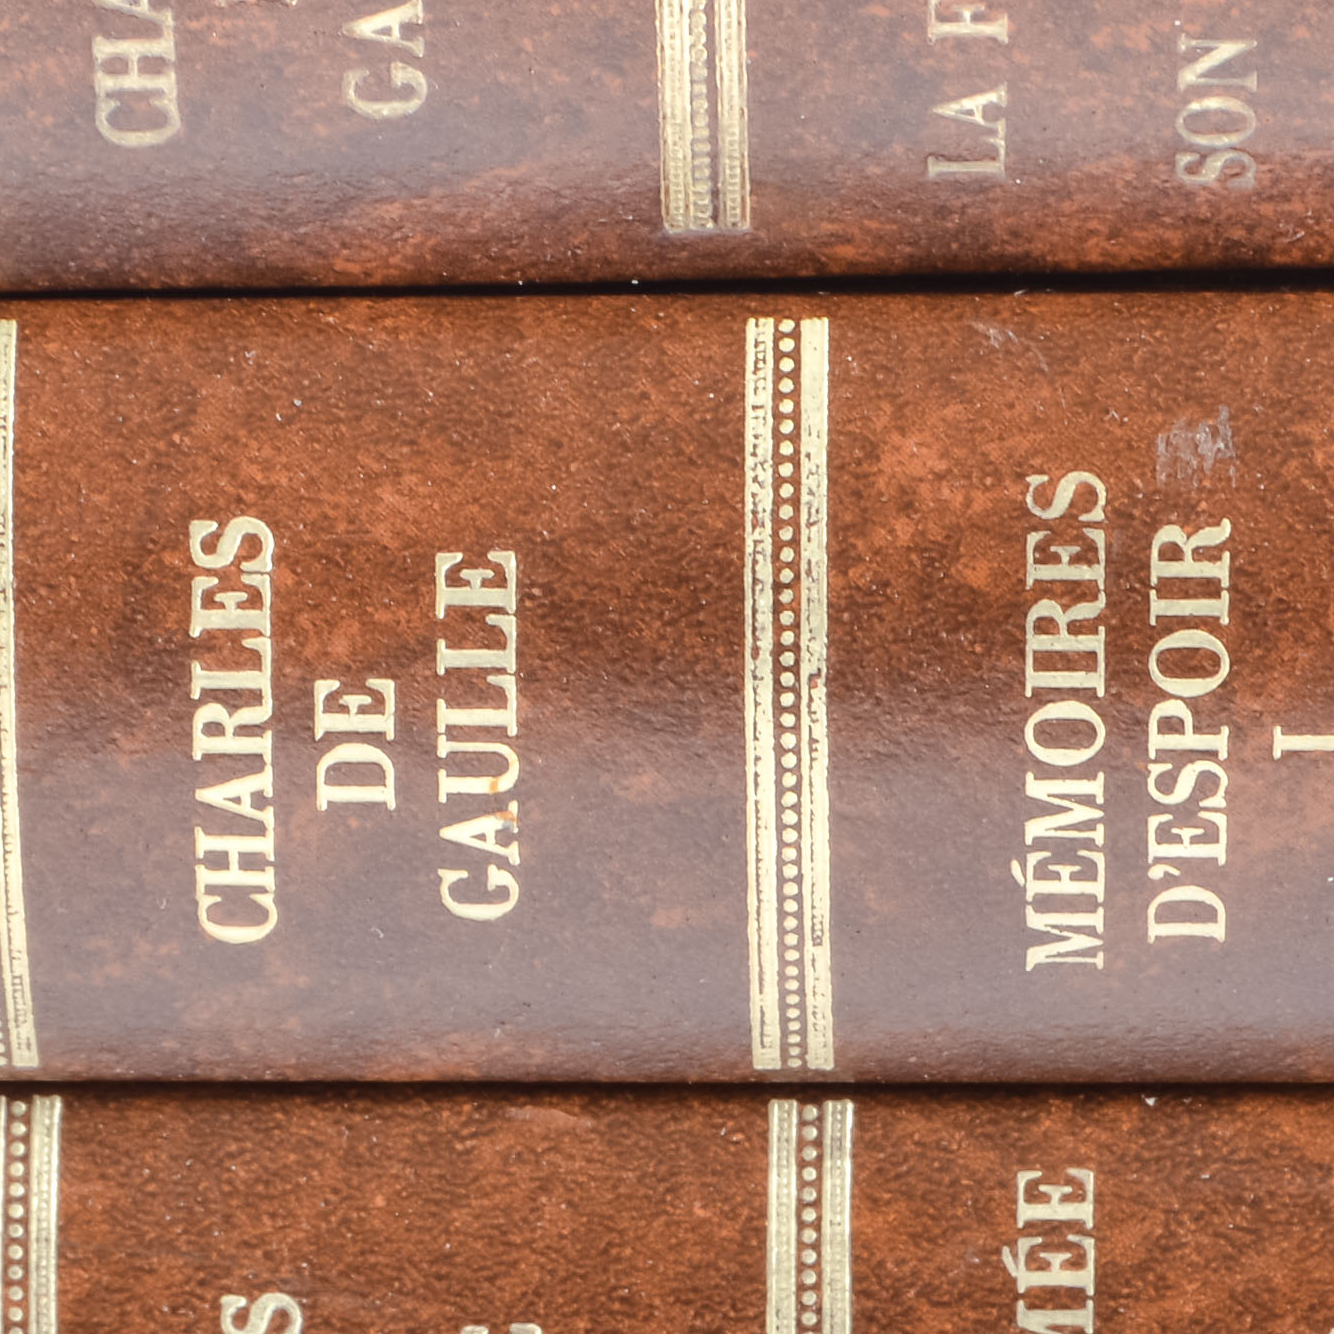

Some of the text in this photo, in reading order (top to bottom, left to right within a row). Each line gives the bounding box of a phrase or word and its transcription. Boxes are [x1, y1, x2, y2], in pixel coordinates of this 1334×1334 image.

[927, 82, 1007, 180] LA
[1176, 36, 1256, 189] SON
[190, 515, 276, 942] CHARLES
[315, 678, 395, 810] DE
[437, 549, 520, 920] GAULLE
[1011, 470, 1107, 970] MÉMOIRES
[1147, 517, 1230, 942] D'ESPOIR
